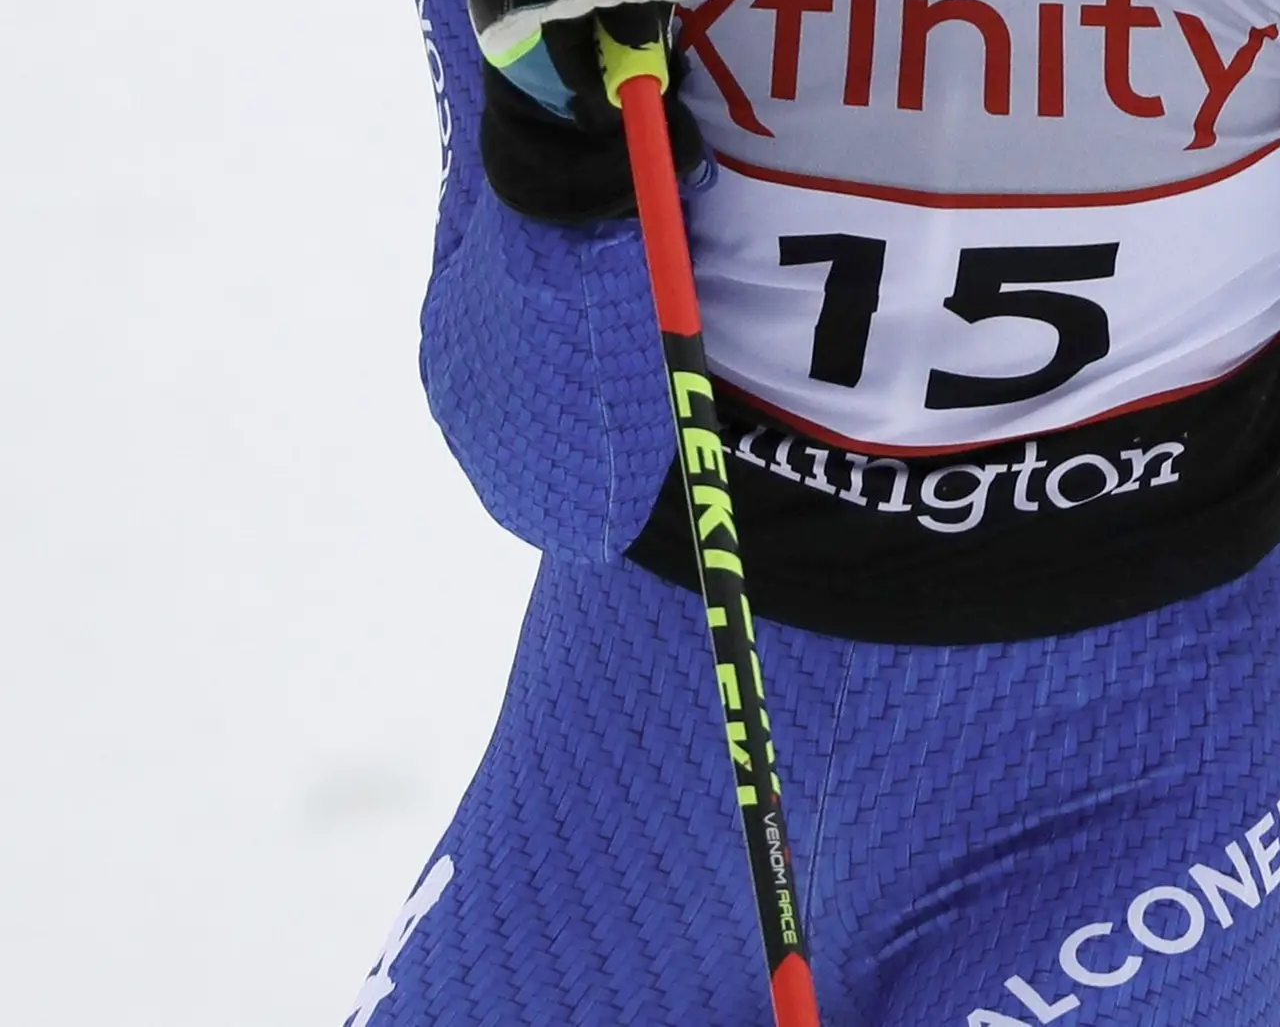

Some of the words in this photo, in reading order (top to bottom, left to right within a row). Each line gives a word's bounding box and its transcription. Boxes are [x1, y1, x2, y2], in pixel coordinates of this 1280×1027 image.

[778, 233, 1120, 410] 15
[673, 371, 745, 579] LEKI
[763, 812, 788, 884] VENOM
